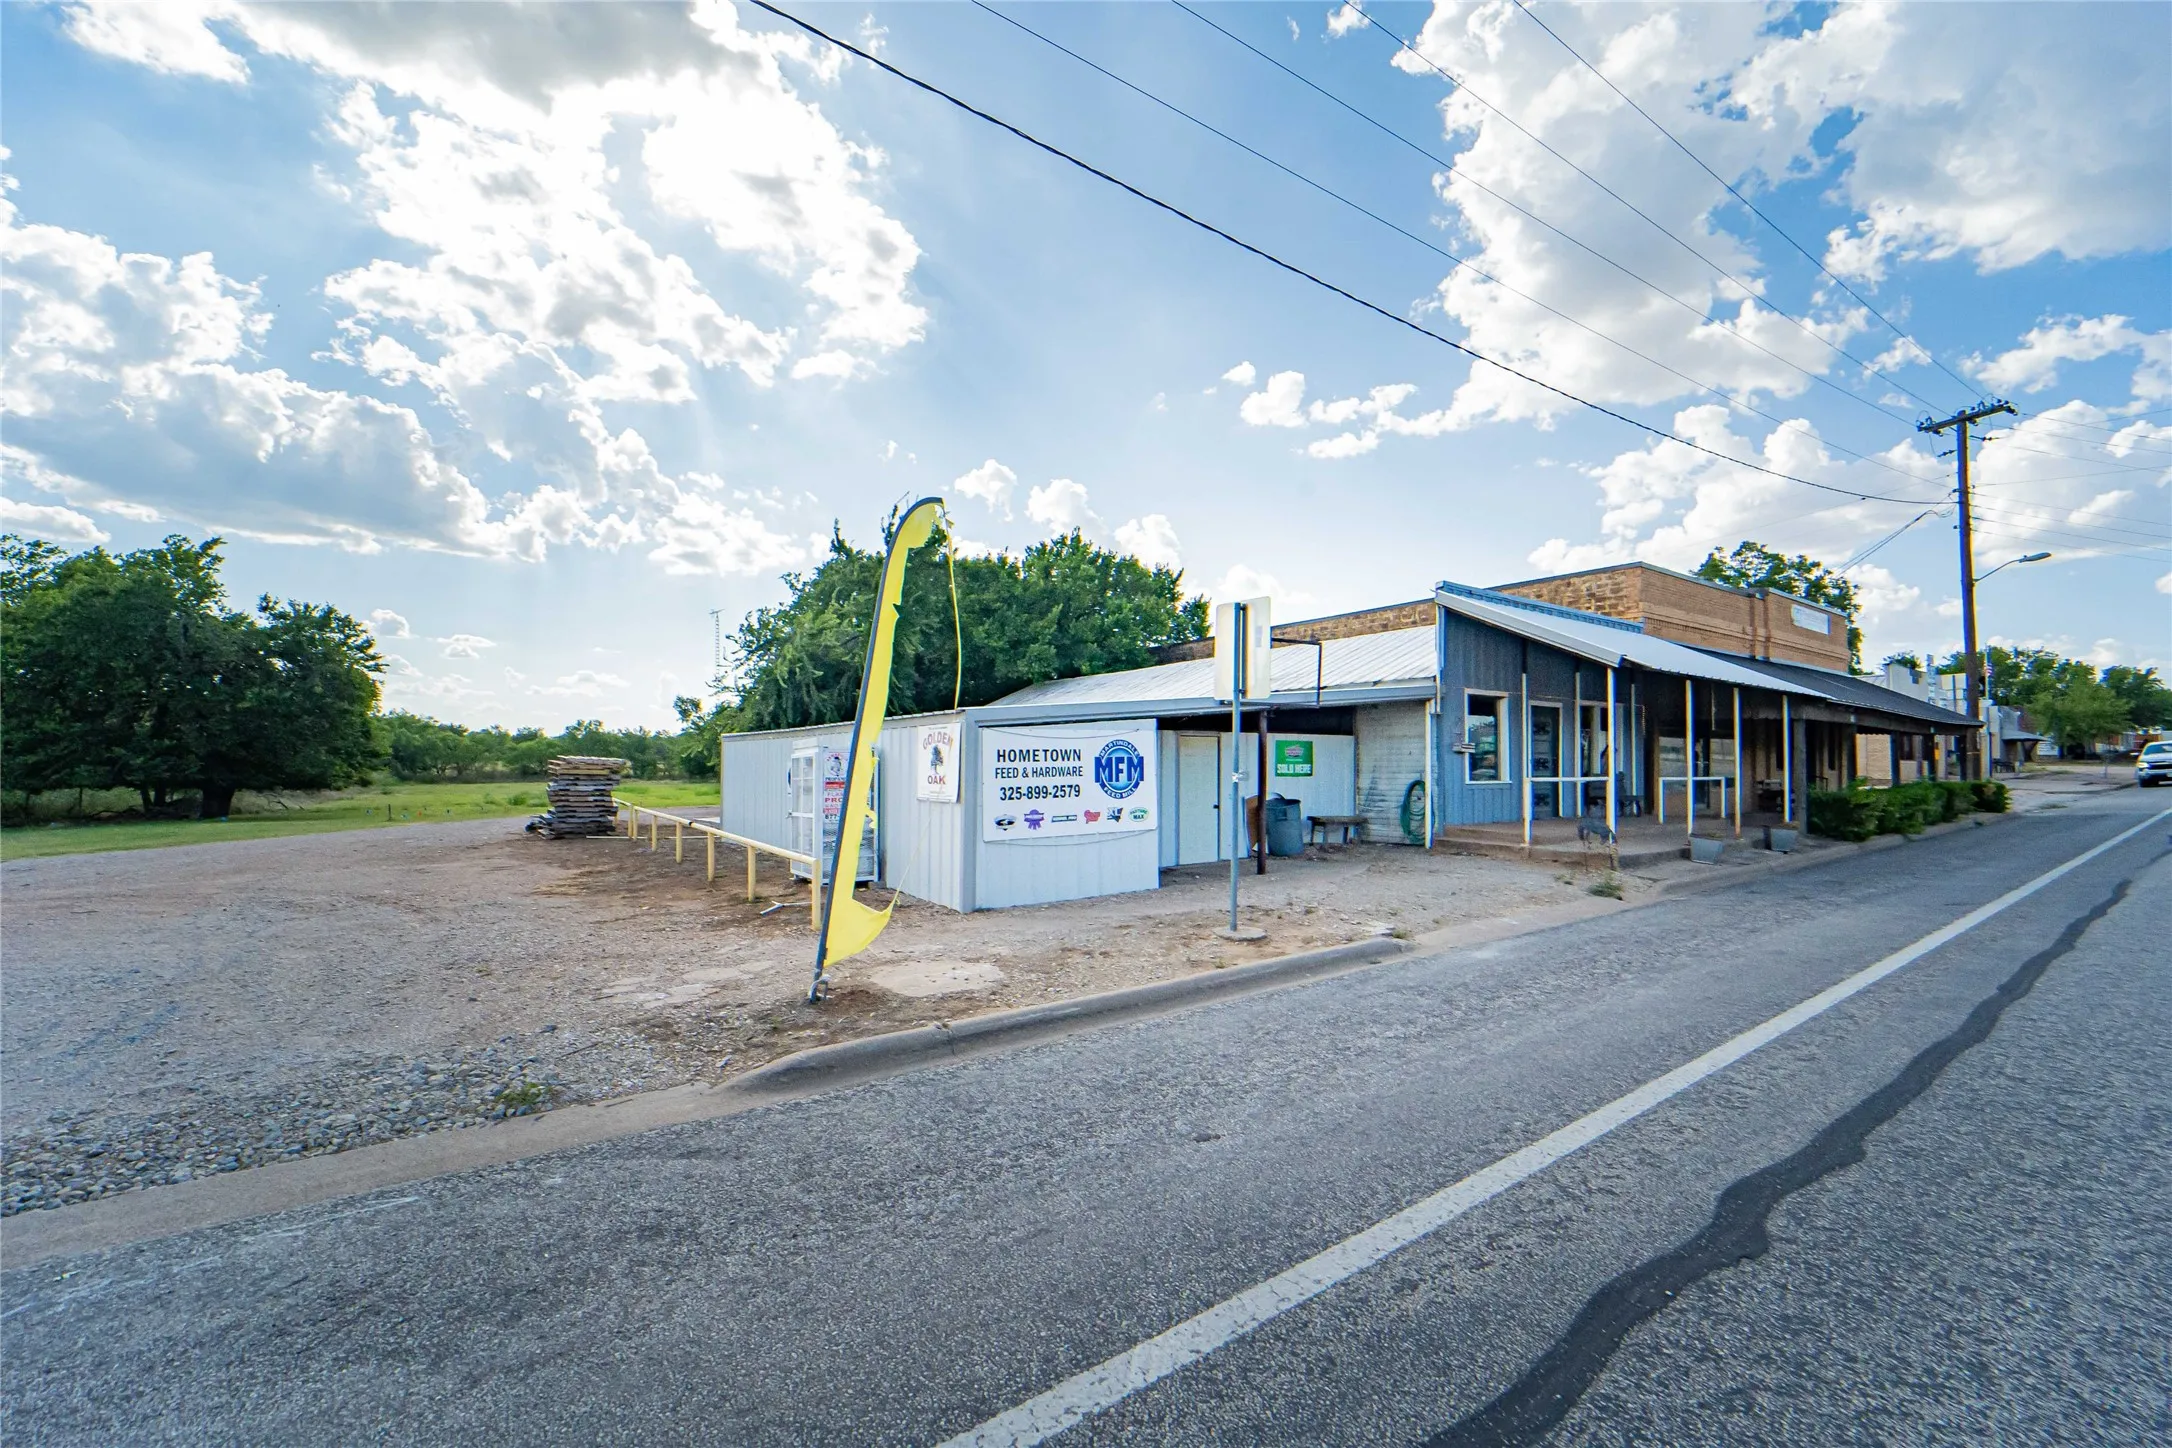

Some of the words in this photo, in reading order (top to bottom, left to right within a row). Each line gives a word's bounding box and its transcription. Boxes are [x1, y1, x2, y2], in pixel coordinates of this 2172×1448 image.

[923, 731, 953, 750] GOLDEN
[1100, 740, 1139, 757] MARTINDALE
[997, 749, 1082, 763] HOMETOWN
[995, 767, 1019, 779] FEED
[1022, 767, 1029, 778] &
[1032, 766, 1084, 778] HARDWARE
[1094, 756, 1144, 783] MFM
[1277, 763, 1294, 774] SOLD
[1295, 763, 1312, 774] HERE
[927, 775, 946, 785] OAK
[1000, 784, 1081, 801] 325-899-2579
[1104, 786, 1121, 798] FEED
[1122, 786, 1137, 798] MILL
